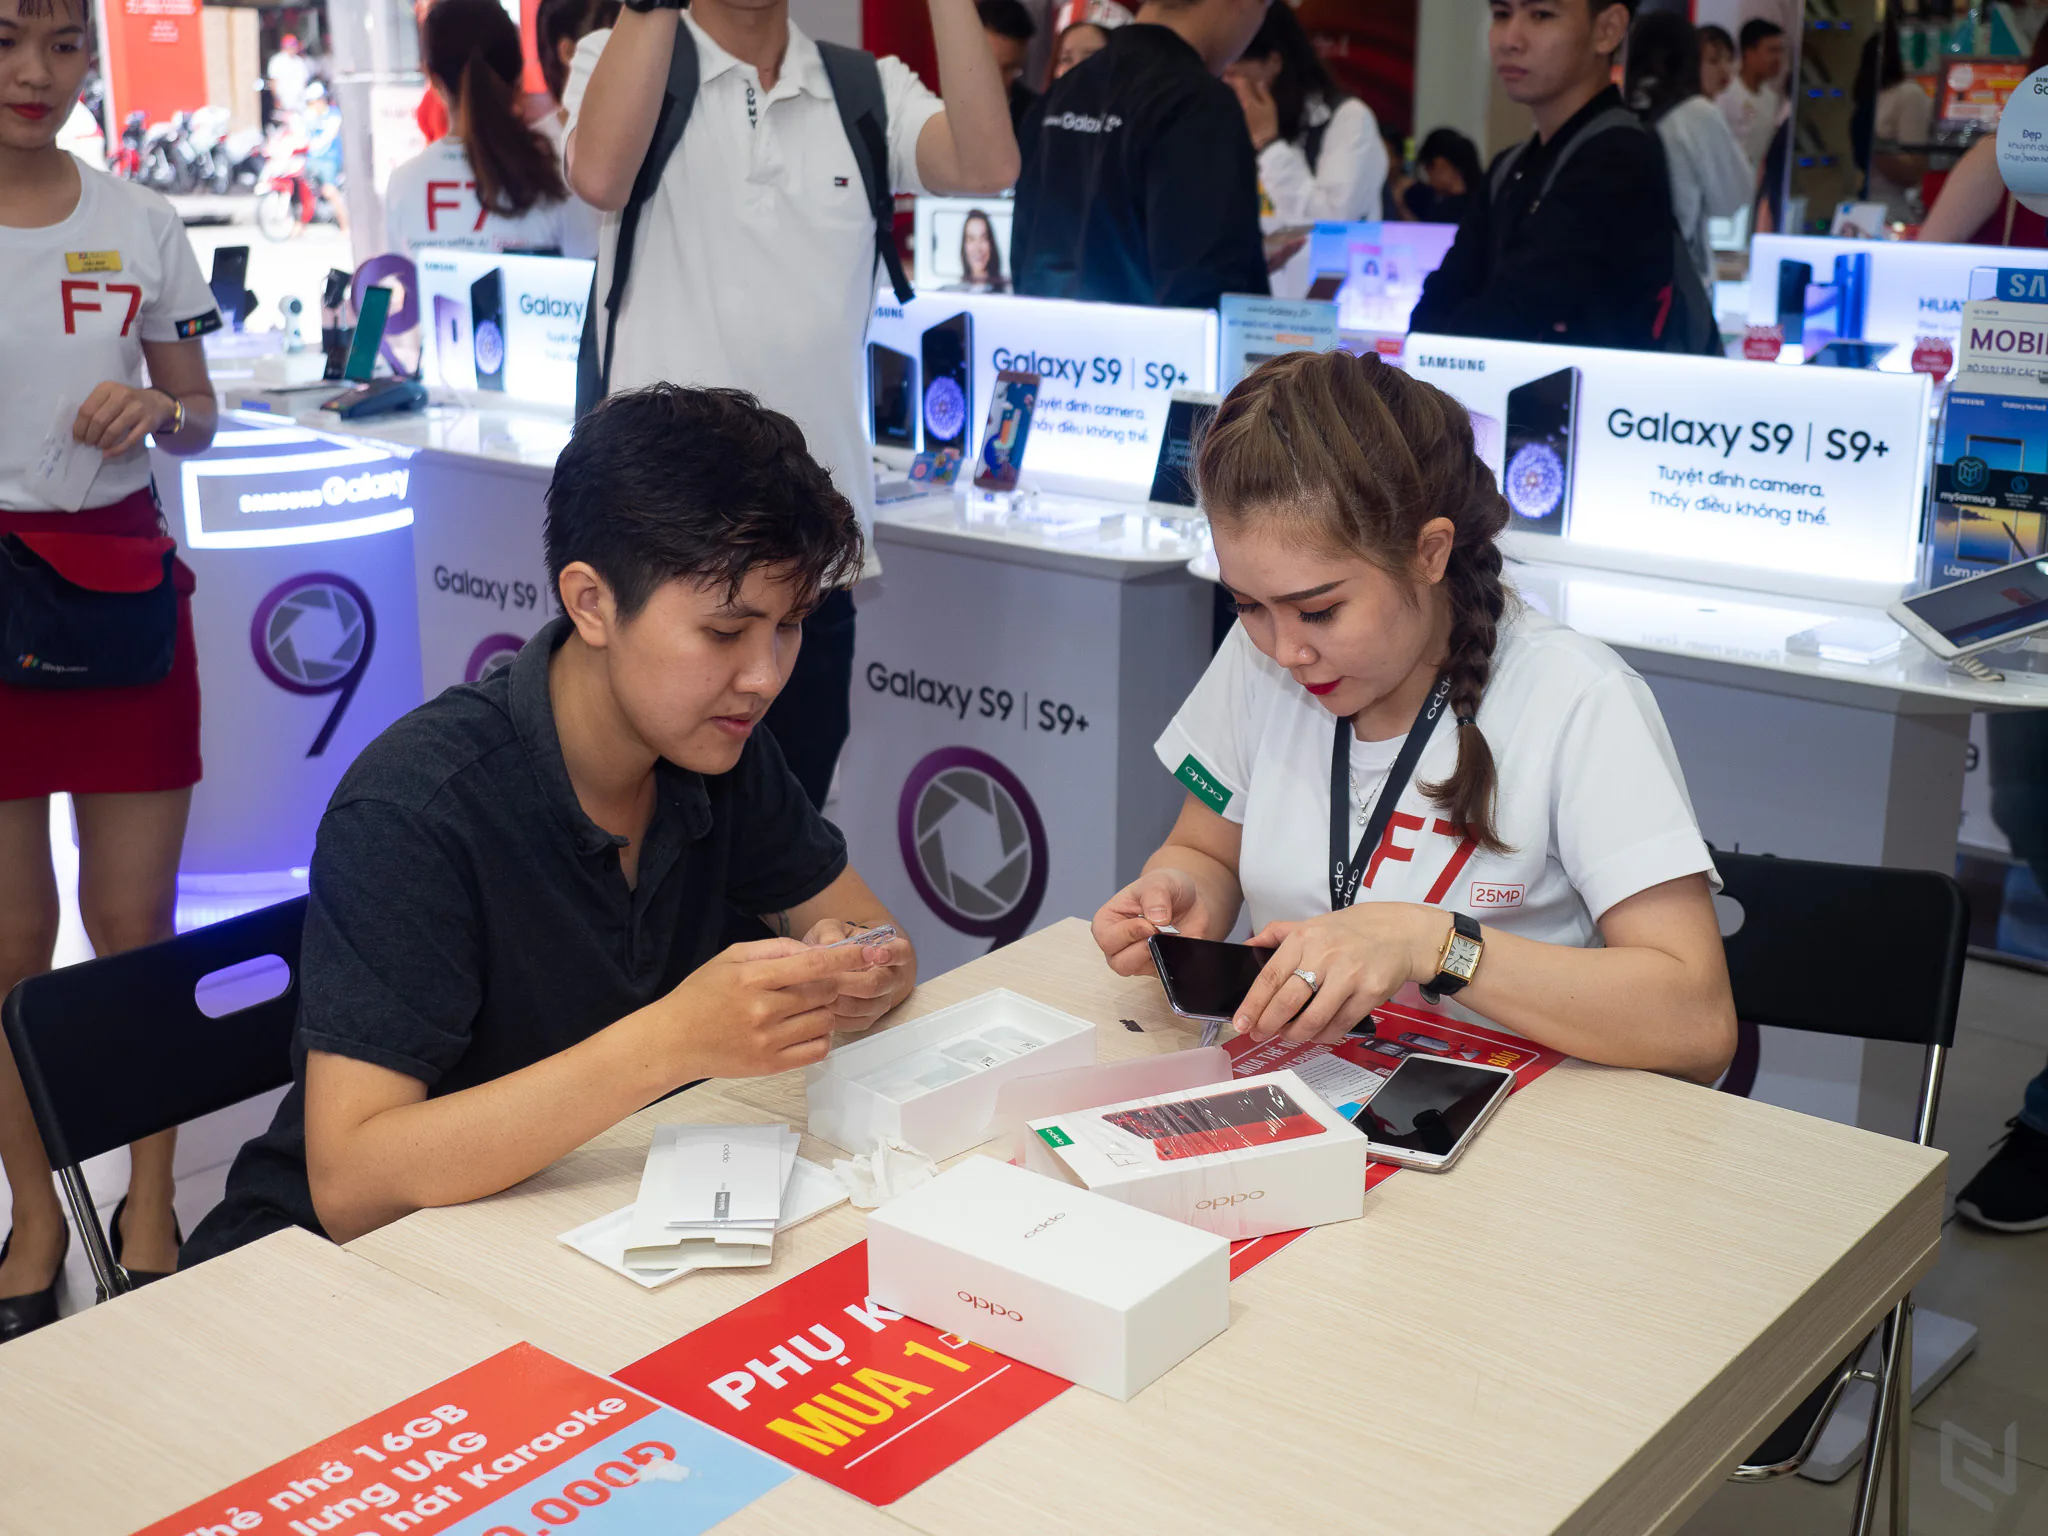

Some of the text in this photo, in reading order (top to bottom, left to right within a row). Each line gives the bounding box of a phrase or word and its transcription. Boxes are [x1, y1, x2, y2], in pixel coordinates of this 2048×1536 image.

[61, 280, 143, 338] F7
[519, 293, 585, 324] Galaxy
[873, 306, 905, 319] SUNG
[1970, 328, 2048, 355] MOBI
[993, 347, 1189, 391] Galaxy S9 S9+
[1418, 354, 1486, 373] SAMSUNG
[1607, 408, 1890, 464] Galaxy S9 S9+
[322, 468, 410, 506] Galaxy
[1658, 465, 1825, 498] Tuyệt đỉnh camera.
[1940, 491, 1997, 507] mySamsung
[434, 564, 537, 611] Galaxy S9
[866, 661, 1090, 736] Galaxy S9 S9+
[1185, 766, 1224, 801] oppo
[1362, 810, 1482, 905] F7
[1475, 888, 1520, 904] 25MP
[1233, 1058, 1269, 1076] MUA
[1045, 1127, 1065, 1146] oppo
[1195, 1189, 1266, 1211] oppo
[1024, 1212, 1066, 1239] oppo
[957, 1290, 1024, 1323] oppo
[707, 1322, 852, 1412] PHỤ
[765, 1340, 972, 1457] MUA 1
[181, 1403, 469, 1536] hẻ nhớ 16GB
[379, 1397, 628, 1532] hát Karaoke
[288, 1431, 489, 1536] lưng UAG
